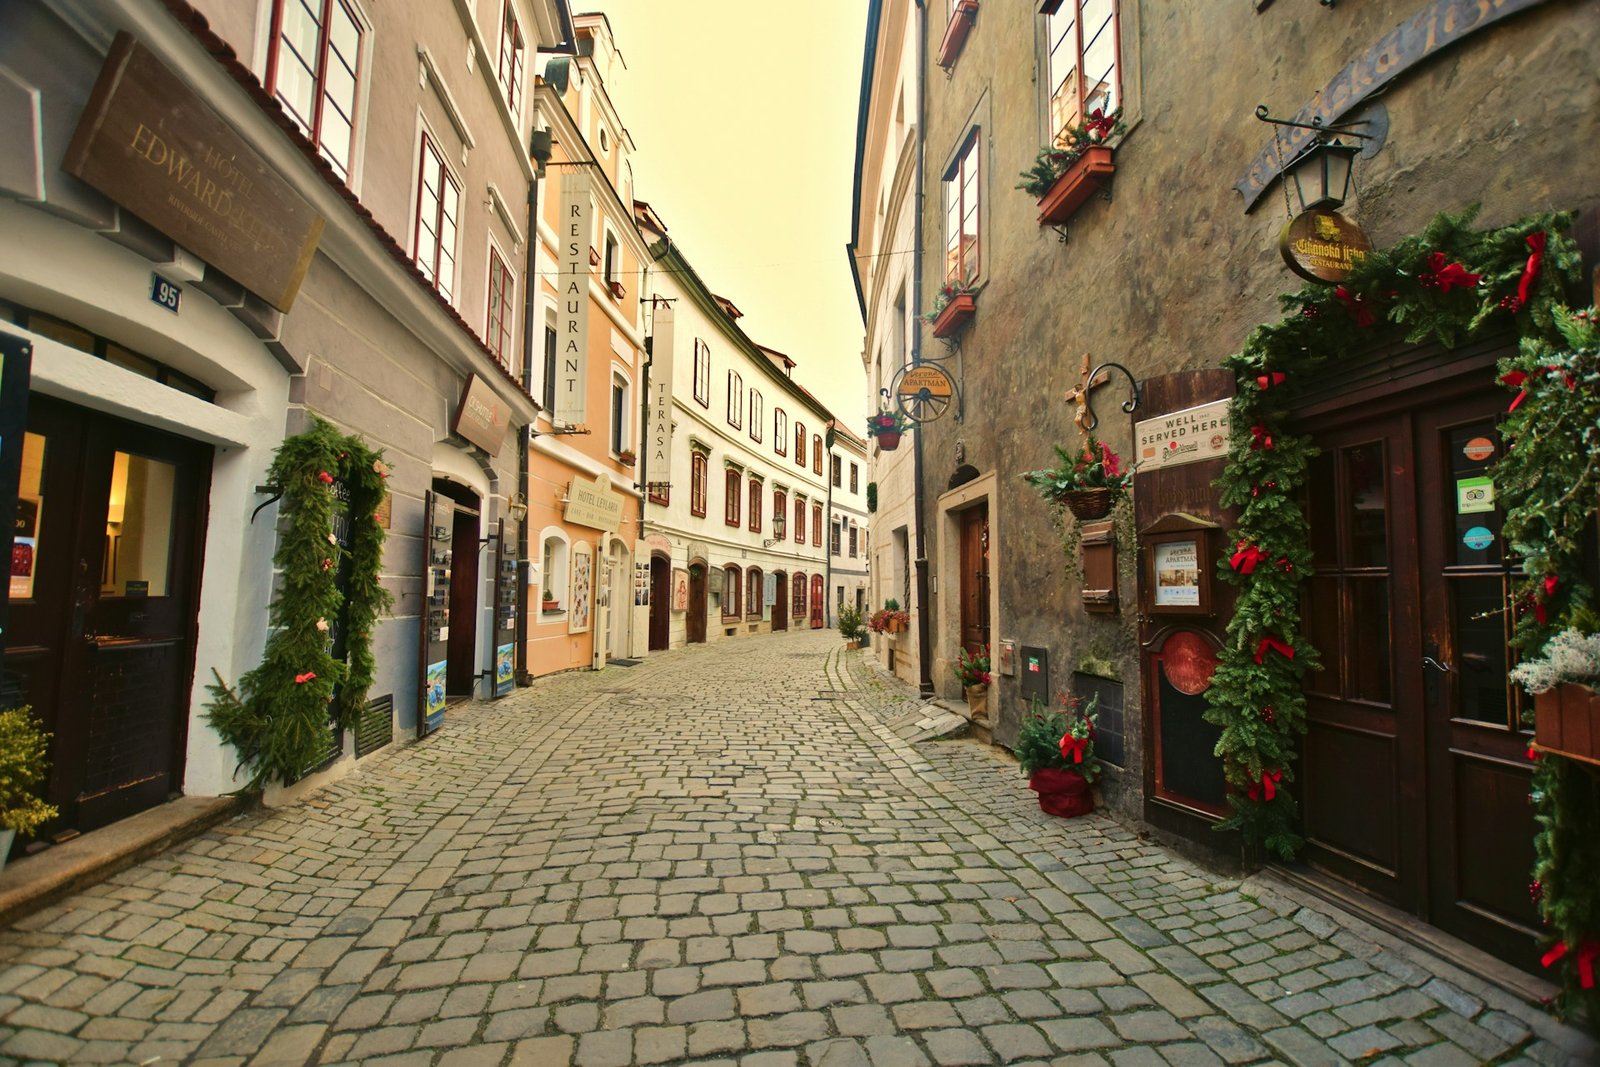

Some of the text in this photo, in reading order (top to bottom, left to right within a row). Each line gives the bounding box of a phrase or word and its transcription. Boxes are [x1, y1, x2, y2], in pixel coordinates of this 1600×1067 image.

[130, 122, 232, 217] EDWARD
[204, 145, 255, 201] HOTEL
[167, 193, 204, 226] RIVERSIDE
[1310, 258, 1353, 271] RESTAURANT
[159, 282, 178, 307] 95
[566, 204, 582, 393] RESTAURANT
[655, 383, 666, 460] TERASA
[1142, 427, 1186, 445] SERVED
[1192, 418, 1228, 433] HERE
[1165, 414, 1197, 429] WELL
[330, 480, 351, 502] offee
[578, 489, 595, 506] HOTEL
